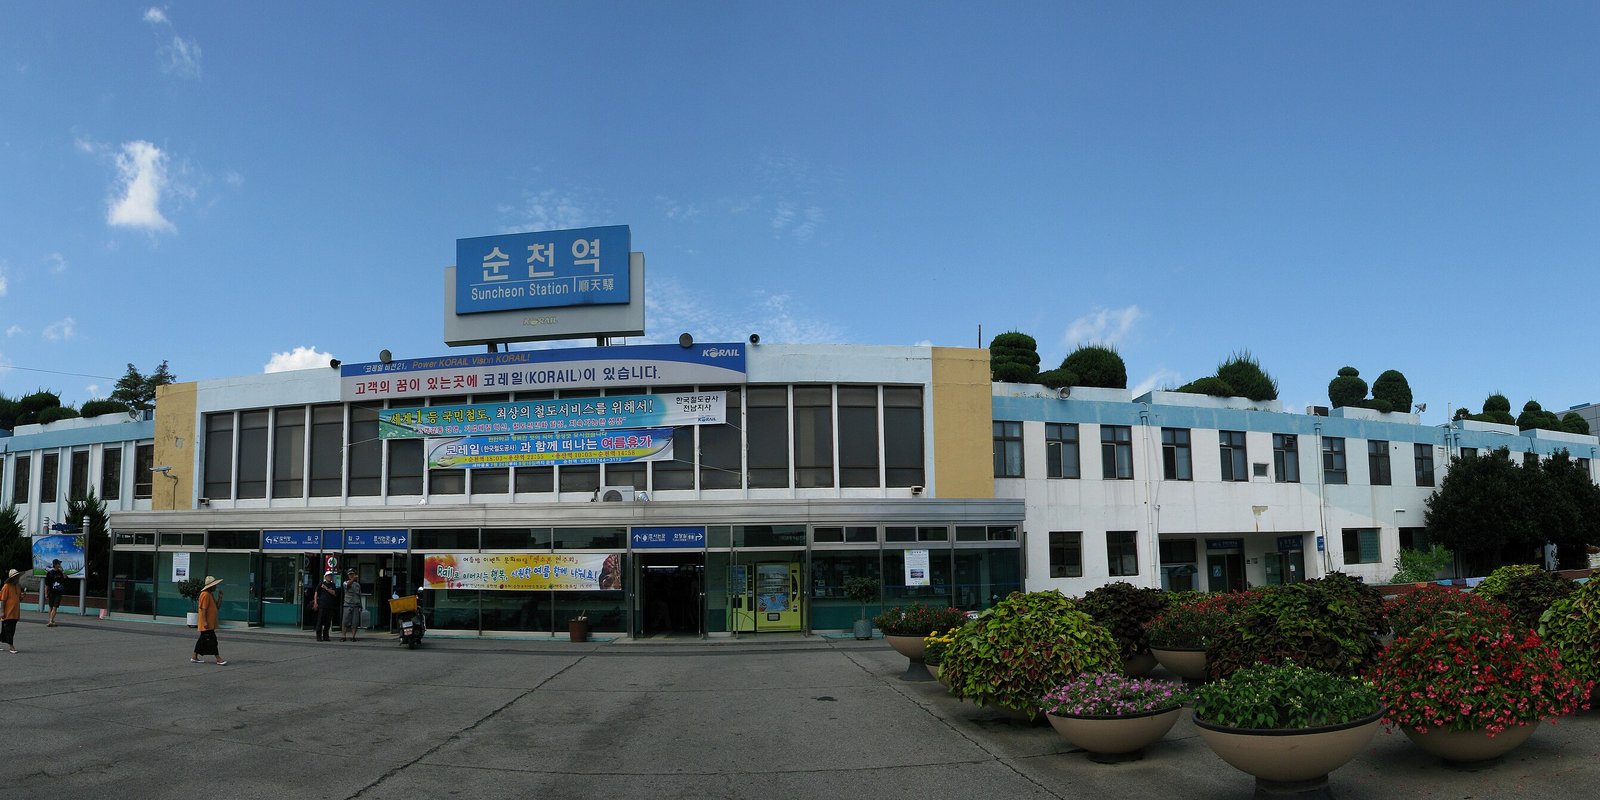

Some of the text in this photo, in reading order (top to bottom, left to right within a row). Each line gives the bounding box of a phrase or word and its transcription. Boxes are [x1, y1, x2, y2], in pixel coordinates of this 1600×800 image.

[482, 239, 600, 282] 순천역
[471, 282, 569, 301] Suncheon Station
[578, 278, 614, 293] 順天驛
[412, 360, 438, 369] Power
[438, 358, 468, 368] KORAIL
[496, 353, 531, 363] KORAIL!
[702, 347, 740, 358] KORAIL
[355, 365, 661, 395] 고객의 꿈이 있는곳에 코레일(KORAIL)이 있습니다.
[675, 395, 719, 405] 한국철도공사
[683, 404, 711, 413] 전남지사
[389, 412, 412, 425] 세계
[442, 408, 492, 423] 국민철도,
[496, 405, 530, 420] 최상의
[534, 402, 607, 418] 철도서비스를
[611, 399, 653, 414] 위해서!
[535, 439, 558, 453] 함께
[562, 438, 598, 451] 떠나는
[601, 434, 652, 449] 여름휴가
[463, 556, 481, 564] 여름밤
[483, 556, 501, 564] 이벤트
[463, 570, 489, 582] 이어지는
[490, 567, 509, 582] 행복,
[511, 565, 532, 579] 시원한
[533, 563, 552, 579] 여름
[553, 564, 568, 578] 함께
